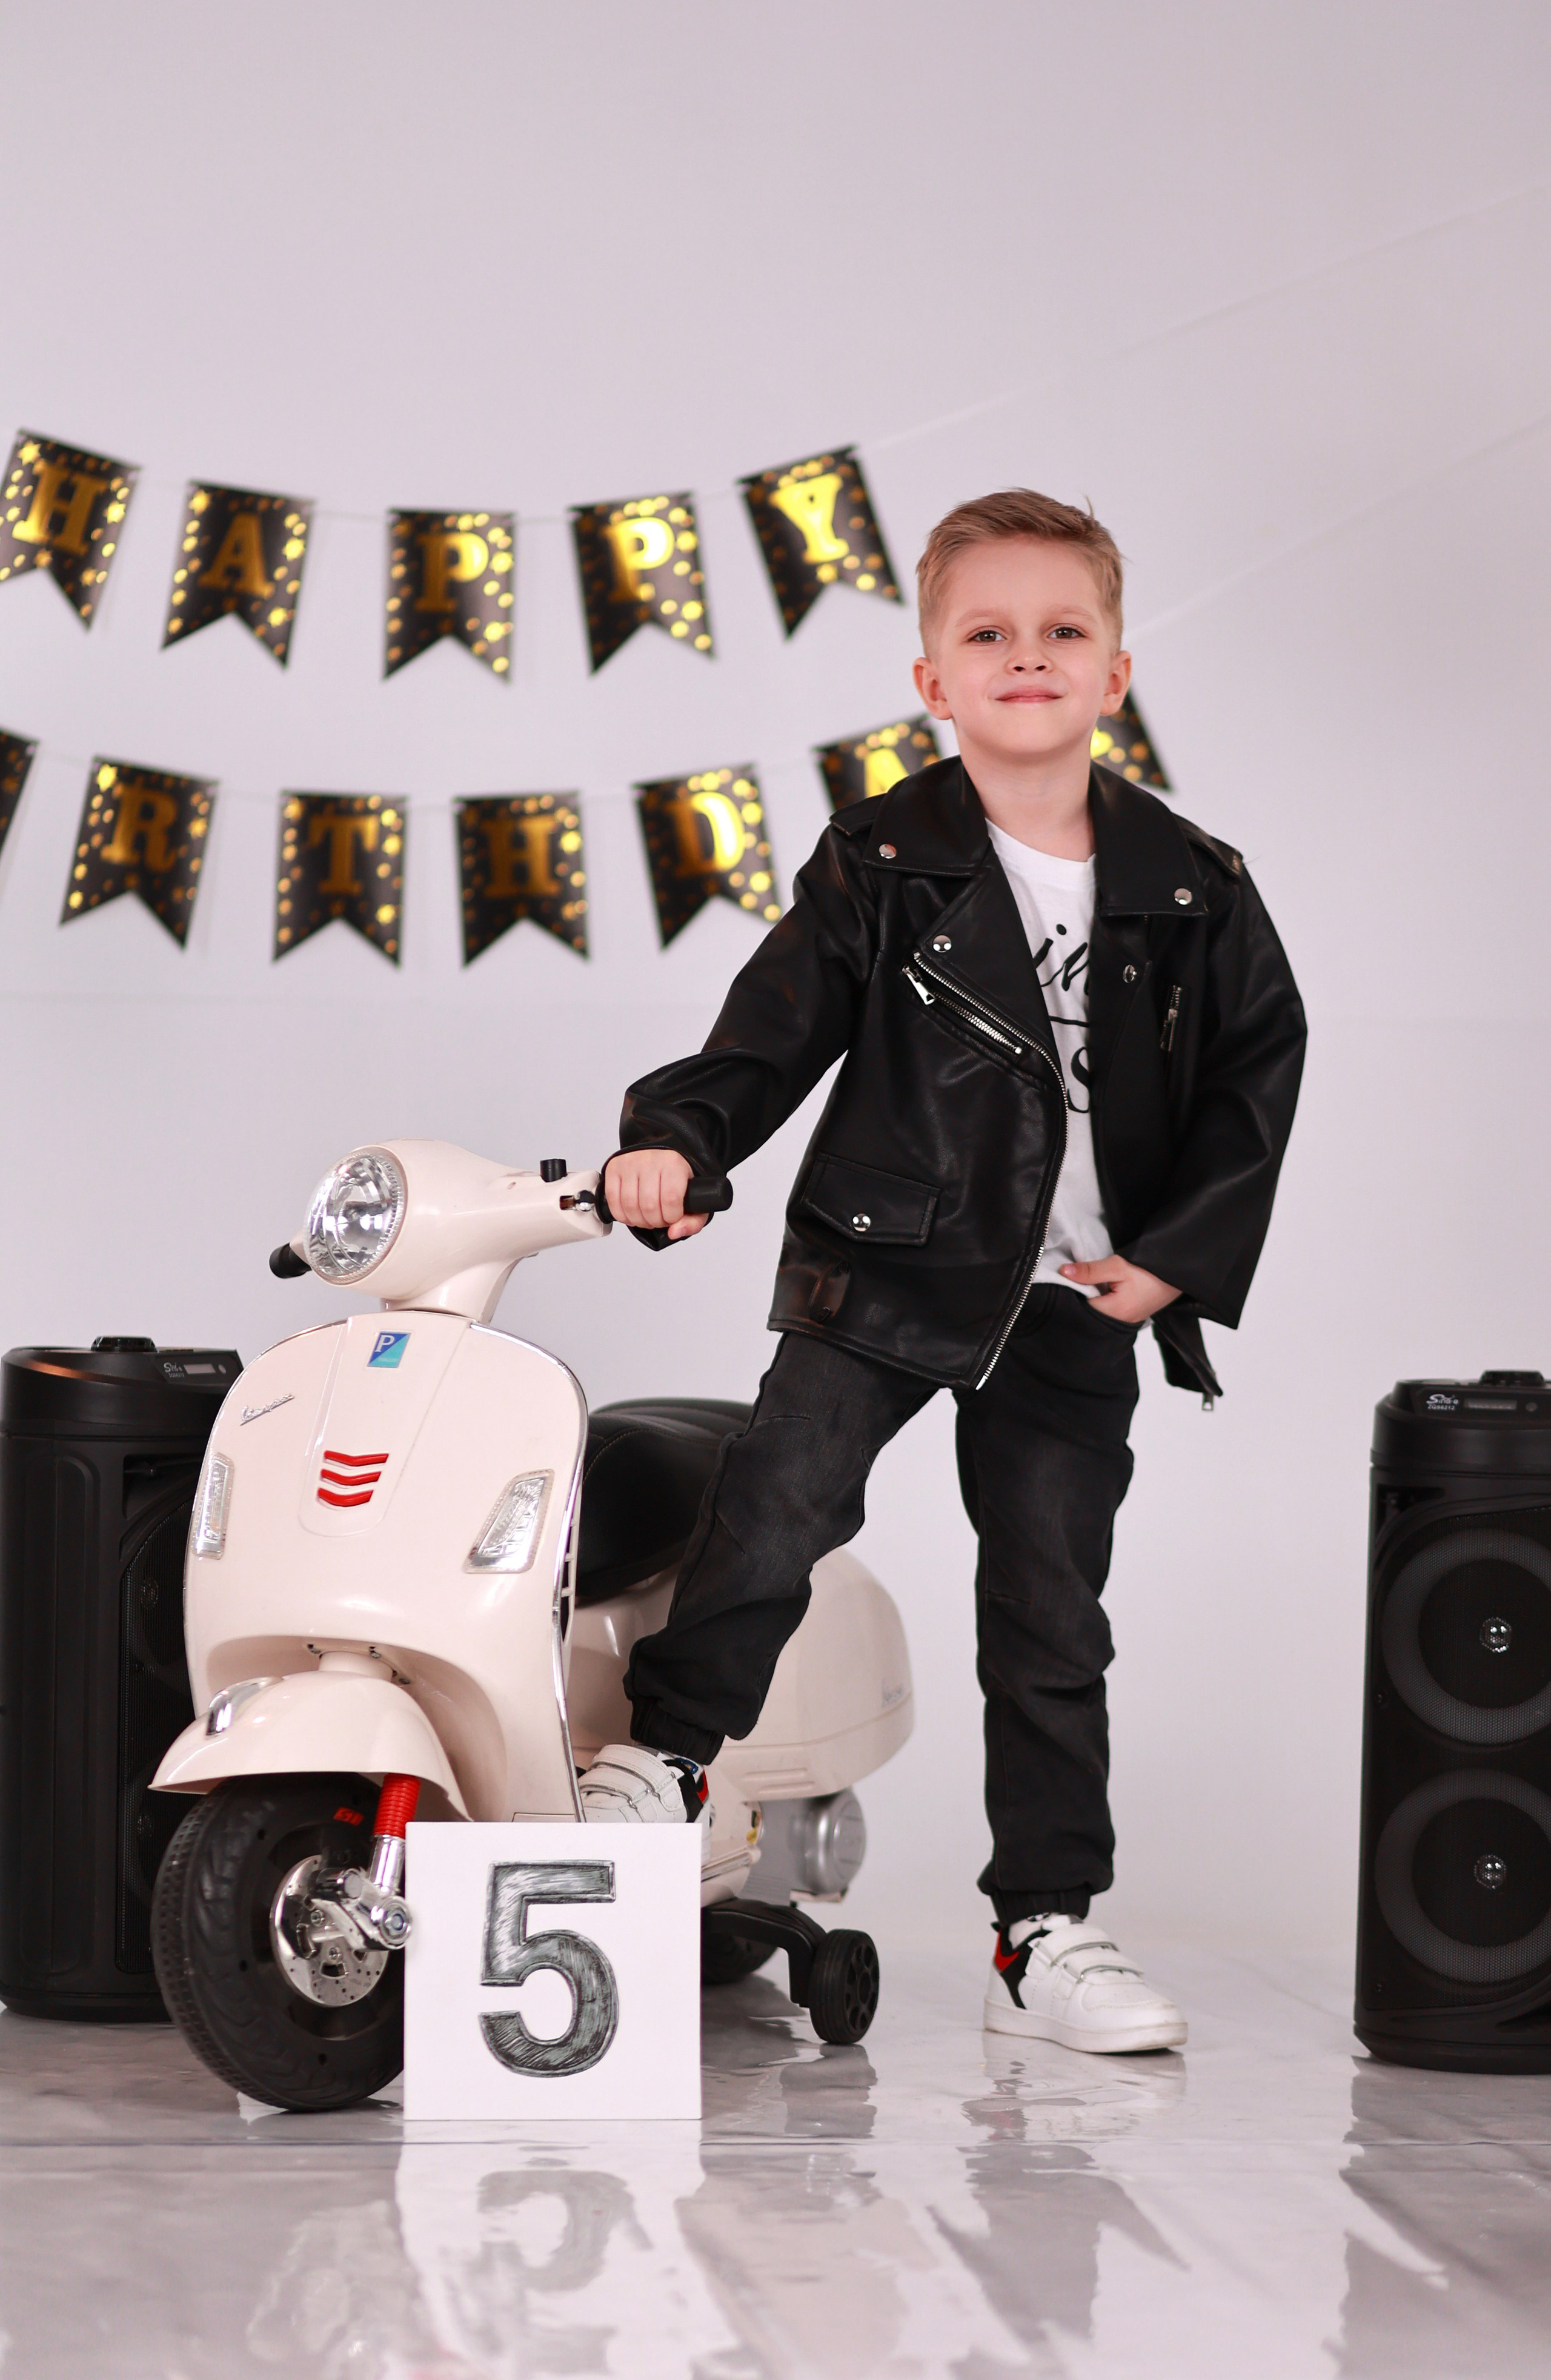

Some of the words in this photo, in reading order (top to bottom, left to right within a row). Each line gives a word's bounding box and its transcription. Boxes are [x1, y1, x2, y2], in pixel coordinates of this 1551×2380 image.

[12, 460, 849, 614] HAPPY
[374, 1334, 395, 1353] P
[479, 1860, 619, 2078] 5
